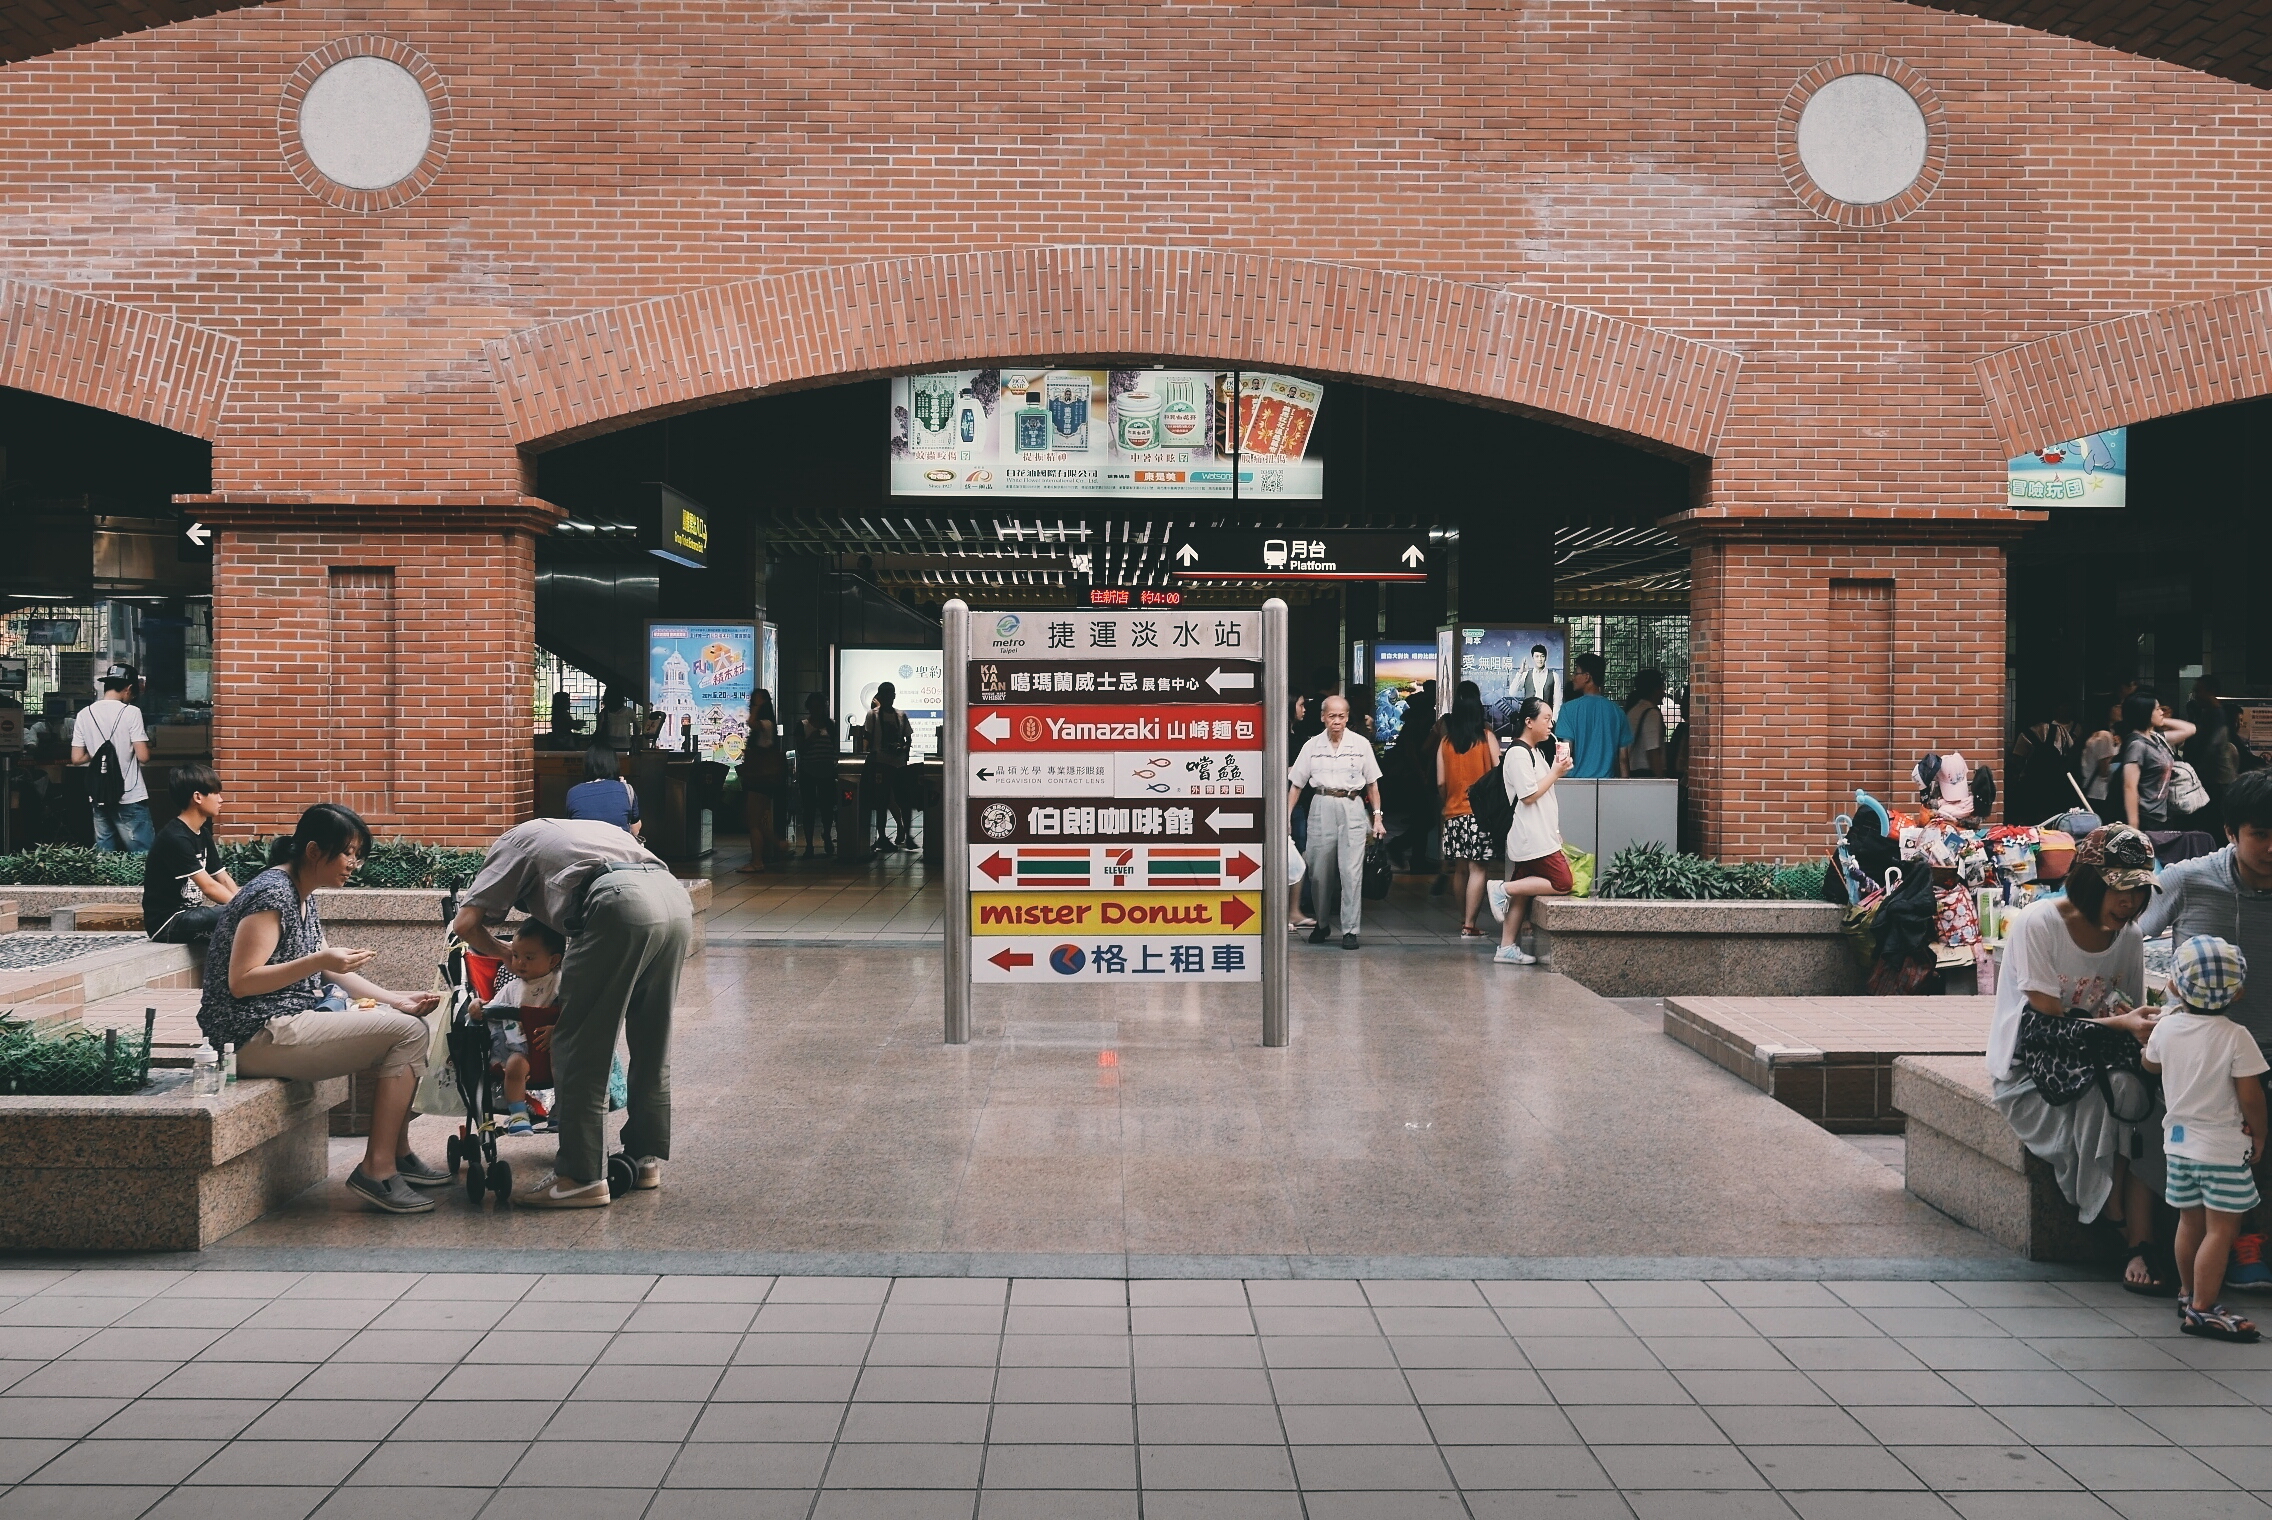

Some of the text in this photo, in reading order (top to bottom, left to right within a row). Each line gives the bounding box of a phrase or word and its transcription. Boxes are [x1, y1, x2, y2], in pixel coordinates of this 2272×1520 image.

[915, 451, 957, 461] 蚊蟲咬傷
[1022, 451, 1068, 462] 提振精神
[1130, 452, 1177, 463] 中暑暈眩
[1144, 472, 1177, 482] 康是美
[2008, 478, 2085, 499] 冒險玩國
[1290, 539, 1327, 558] 月台
[1290, 560, 1337, 571] Platform
[1090, 590, 1180, 604] 往新店 約4:00
[1047, 620, 1242, 649] 捷運淡水站
[992, 638, 1026, 648] metro
[1000, 647, 1018, 655] Taipei
[1461, 654, 1513, 670] 愛 無阻隔
[980, 664, 998, 674] KA
[981, 673, 998, 683] VA
[1010, 671, 1200, 692] 噶瑪蘭威士忌 展售中心
[981, 682, 1006, 691] LAN
[1045, 717, 1255, 740] Yamazaki 山崎麵包
[995, 765, 1105, 776] 晶碩光學 專業隱形眼鏡
[1027, 807, 1194, 835] 伯朗咖啡館
[987, 829, 1009, 838] COFFEE
[1101, 902, 1213, 925] Donut
[1091, 943, 1246, 974] 格上租車
